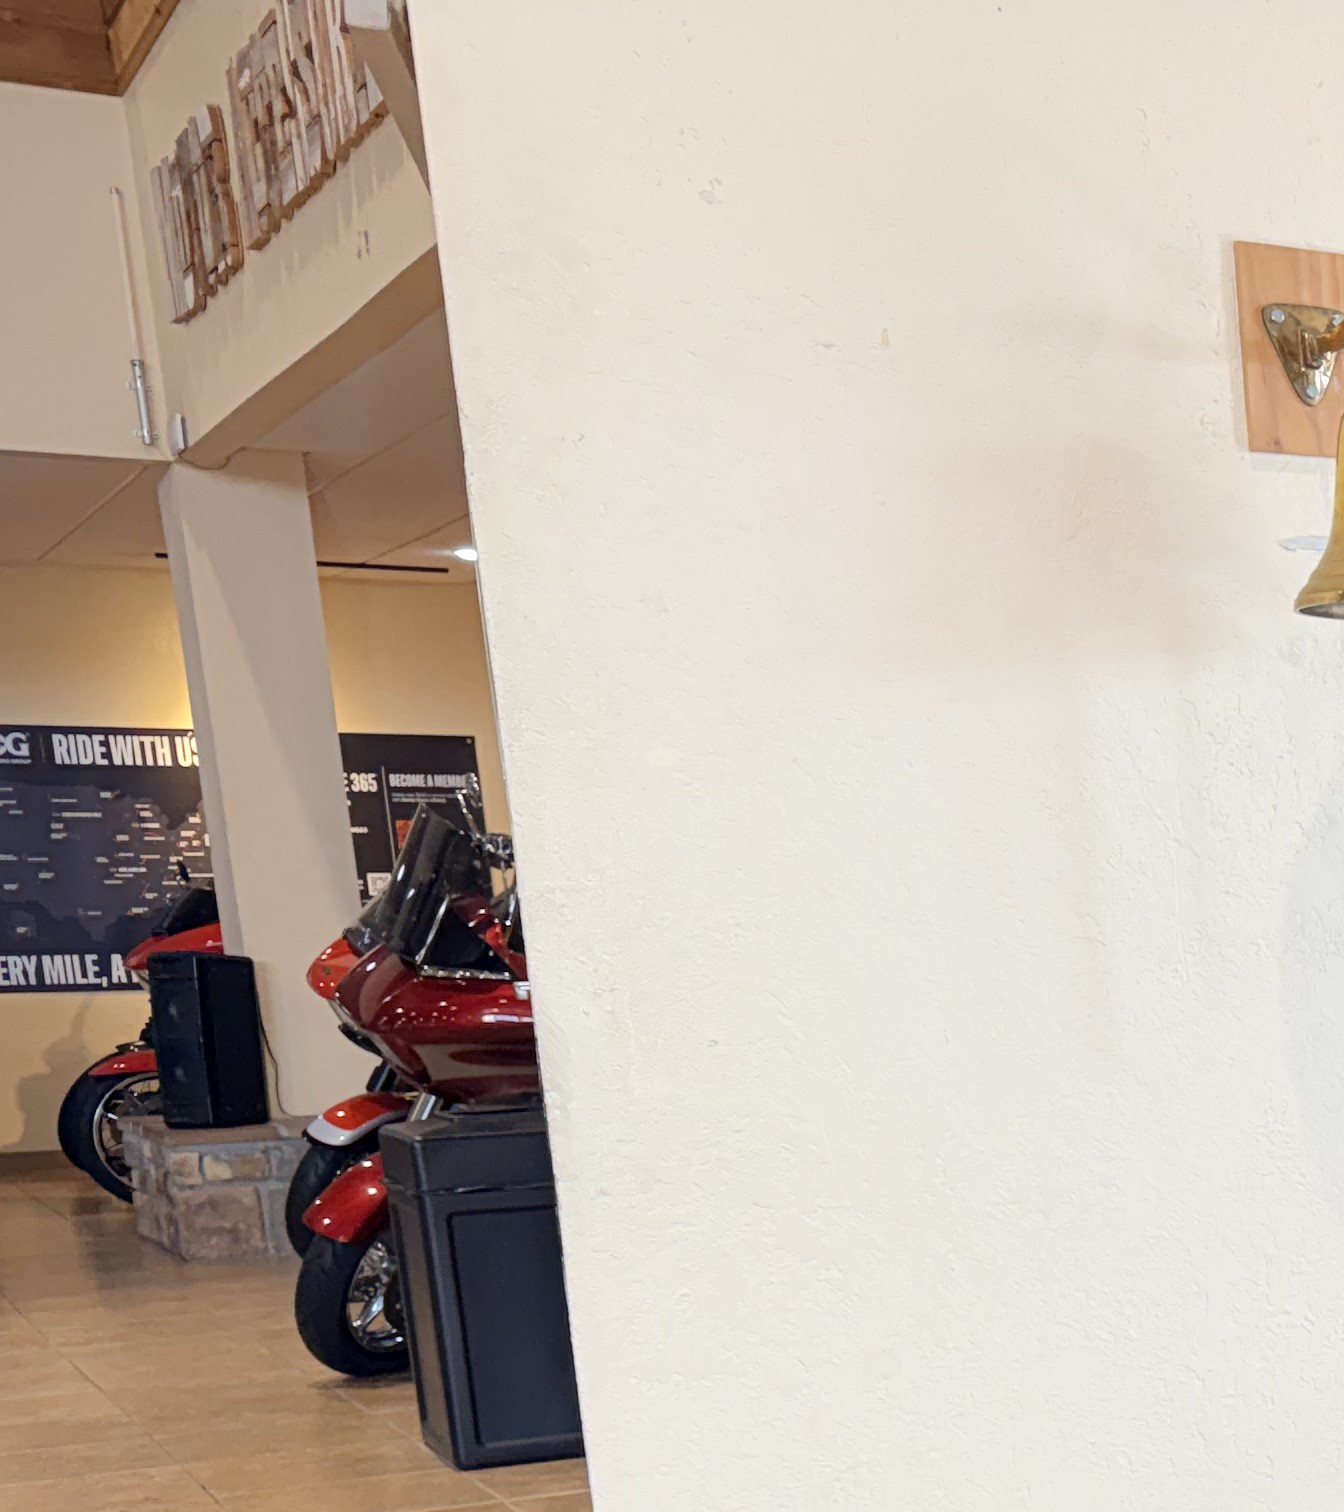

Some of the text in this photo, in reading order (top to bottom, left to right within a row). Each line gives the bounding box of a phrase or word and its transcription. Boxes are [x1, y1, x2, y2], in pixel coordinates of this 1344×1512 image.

[51, 734, 108, 765] RIDE
[108, 735, 172, 766] WITH
[350, 772, 378, 793] 365
[388, 773, 426, 788] BECOME
[41, 953, 108, 988] MILE,
